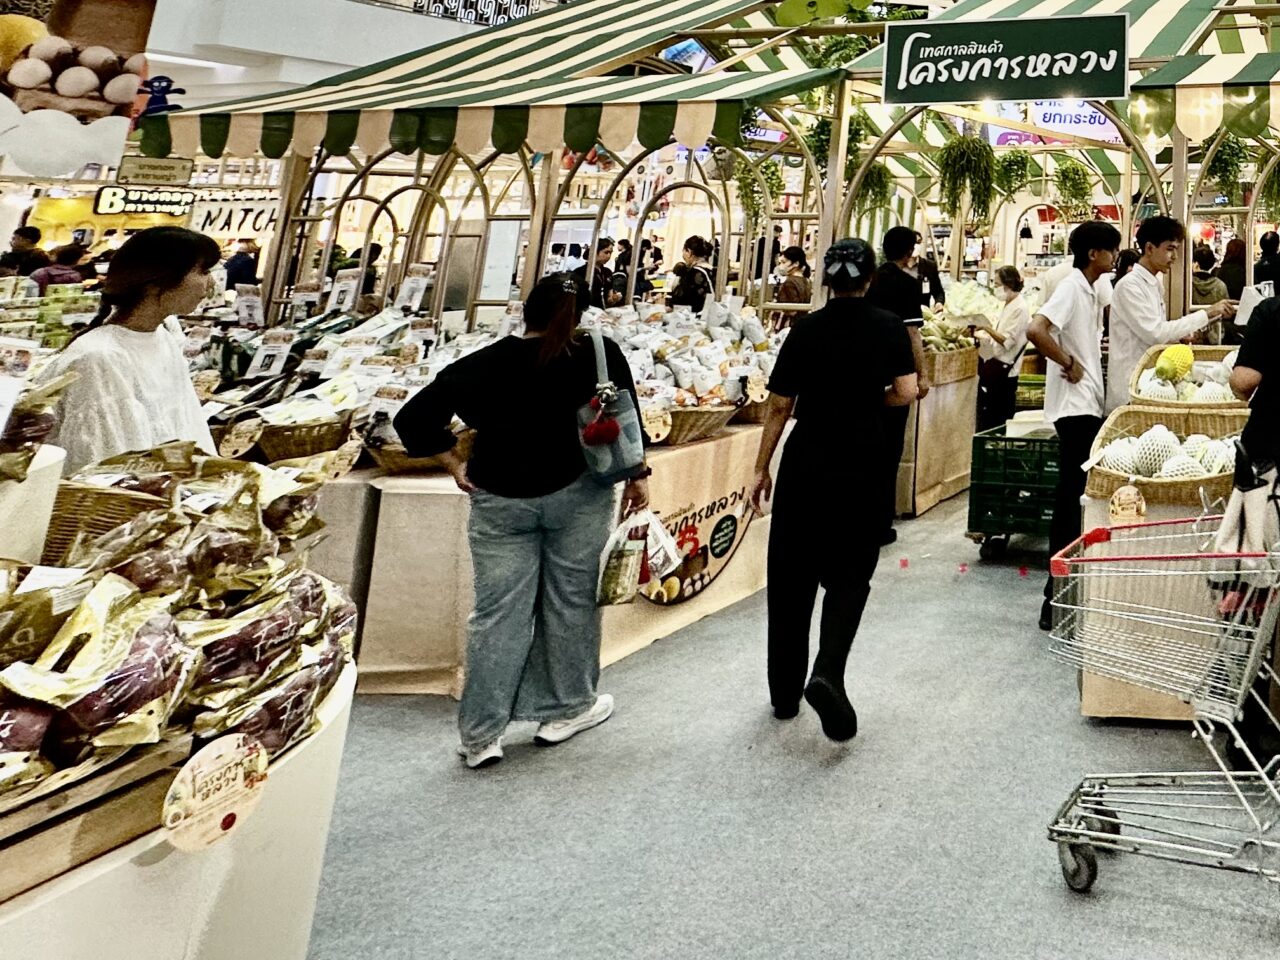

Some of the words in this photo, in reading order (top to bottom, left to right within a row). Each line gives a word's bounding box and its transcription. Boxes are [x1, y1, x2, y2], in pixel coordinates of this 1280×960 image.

[897, 32, 1118, 90] โครงการหลวง
[920, 40, 1003, 59] เทศกาลสินค้า
